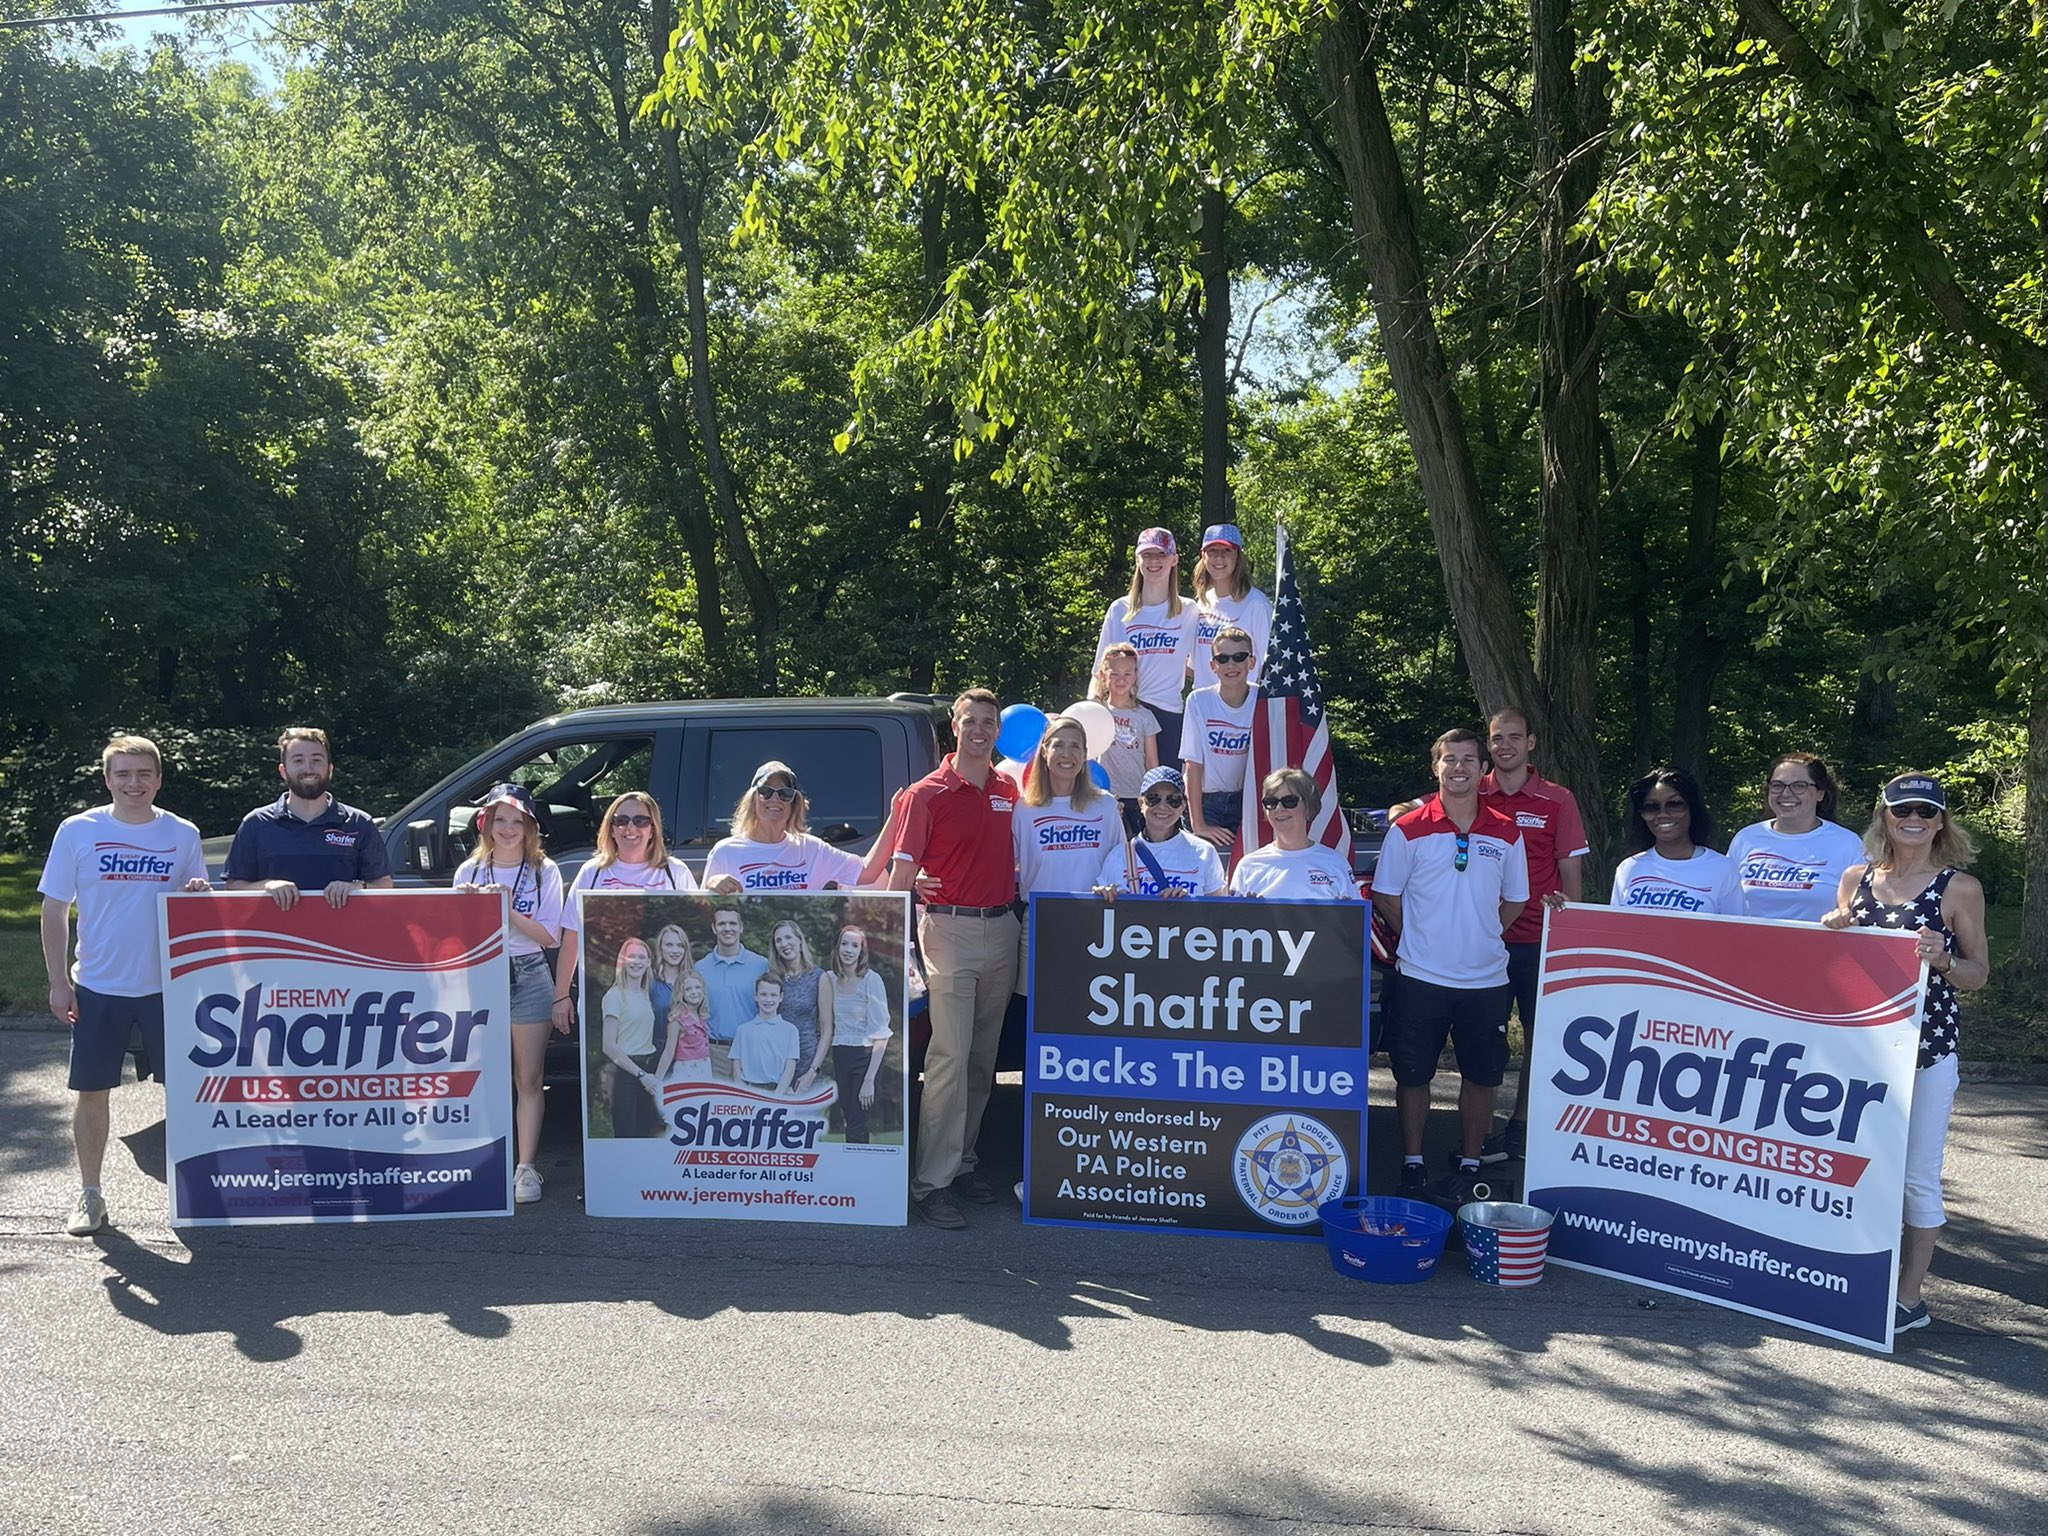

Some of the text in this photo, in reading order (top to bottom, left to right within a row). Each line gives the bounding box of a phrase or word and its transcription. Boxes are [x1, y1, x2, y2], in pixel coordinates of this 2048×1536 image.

[1129, 631, 1179, 649] Shaffer
[1039, 824, 1101, 845] Shaffer
[98, 852, 174, 874] Shaffer
[1744, 862, 1820, 883] Shaffer
[745, 870, 808, 889] Shaffer
[1627, 885, 1705, 912] Shaffer
[1087, 908, 1316, 976] Jeremy
[264, 988, 351, 1008] JEREMY
[1087, 973, 1312, 1034] Shaffer
[187, 982, 490, 1071] Shaffer
[1640, 1019, 1735, 1051] JEREMY
[1039, 1046, 1355, 1096] Backs The Blue
[1550, 1009, 1889, 1144] Shaffer
[241, 1075, 450, 1100] U.S. CONGRESS
[212, 1104, 471, 1128] A Leader for All of Us!
[711, 1104, 756, 1116] JEREMY
[1044, 1103, 1222, 1131] Proudly endorsed by
[670, 1101, 825, 1150] Shaffer
[1252, 1122, 1335, 1151] PITT LODGE #1
[1058, 1126, 1207, 1155] Our Western
[1605, 1113, 1835, 1179] U.S. CONGRESS
[697, 1152, 804, 1167] U.S. CONGRESS
[1076, 1153, 1187, 1180] PA Police
[210, 1166, 472, 1191] www.jeremyshaffer.com
[681, 1168, 814, 1183] A Leader for All of Us!
[1239, 1156, 1260, 1204] FRATERNAL
[1570, 1142, 1854, 1220] A Leader for All of Us!
[640, 1187, 856, 1208] www.jeremyshaffer.com
[1057, 1178, 1207, 1208] Associations
[1268, 1207, 1311, 1221] ORDER OF
[1563, 1210, 1849, 1294] www.jeremyshaffer.com
